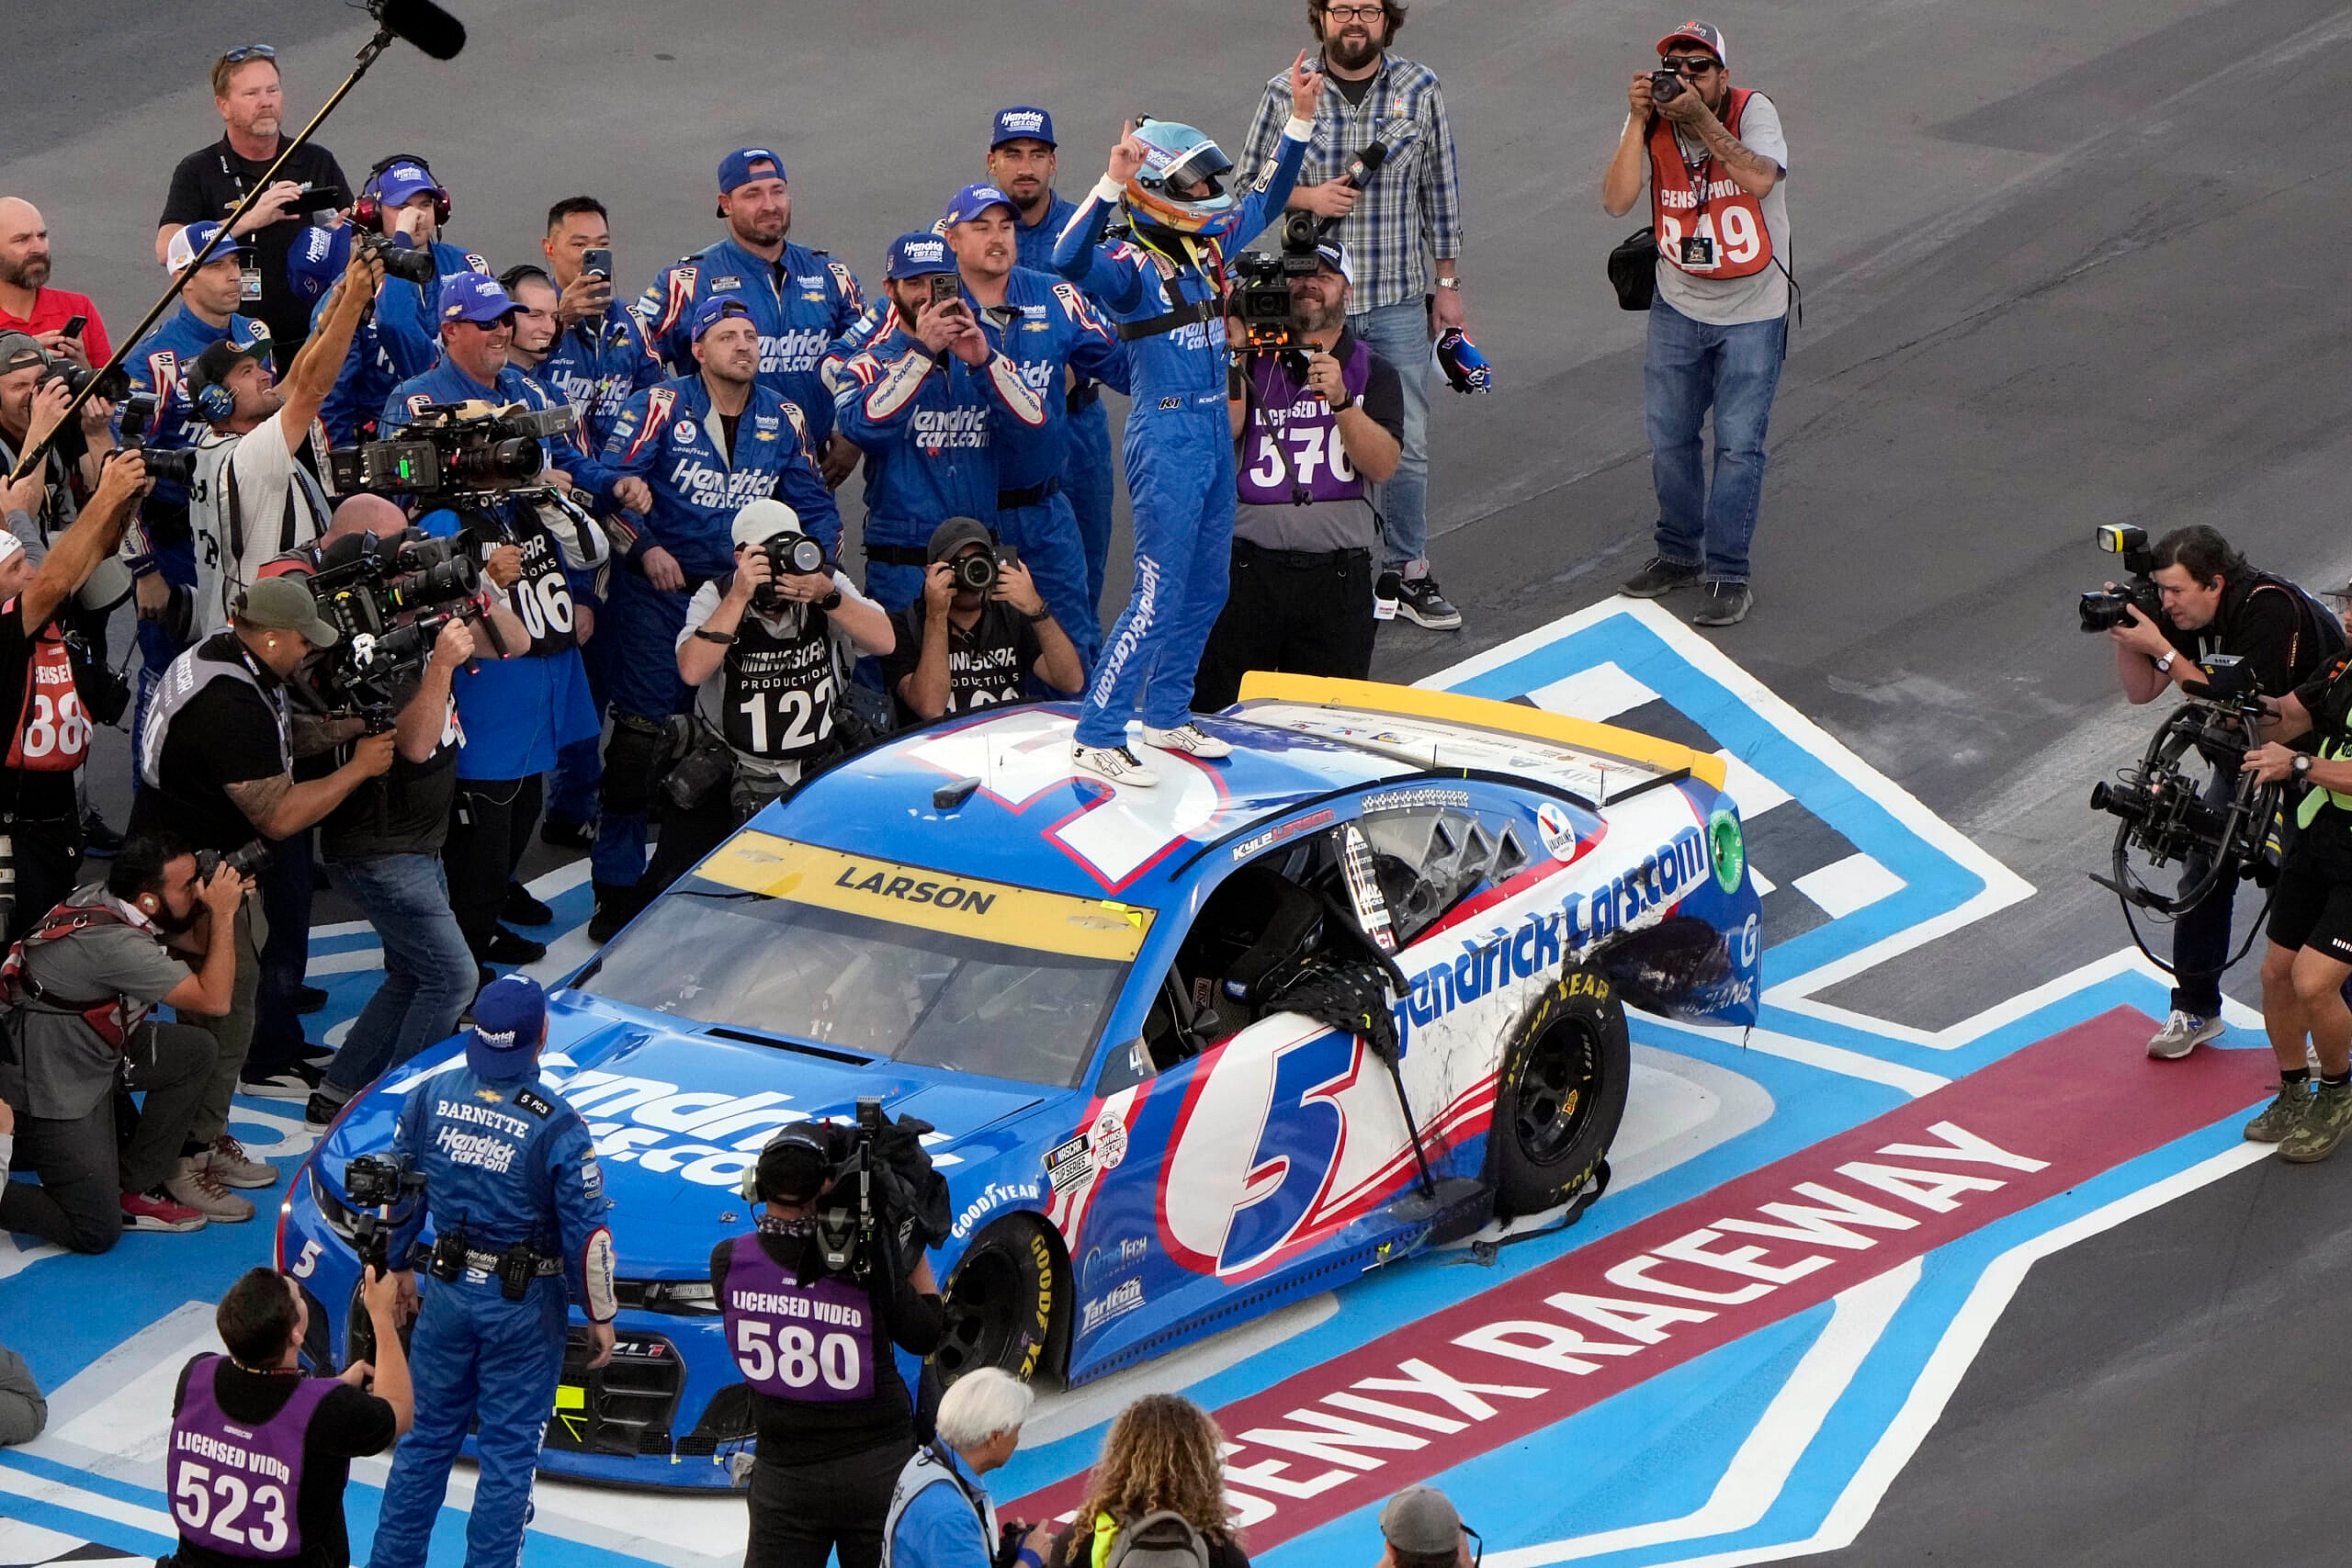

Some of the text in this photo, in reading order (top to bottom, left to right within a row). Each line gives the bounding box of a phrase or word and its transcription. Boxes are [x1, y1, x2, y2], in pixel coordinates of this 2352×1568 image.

[1661, 188, 1698, 209] CENS
[758, 328, 831, 356] ndrick
[670, 458, 781, 497] Hendrick
[691, 490, 770, 510] cars.co
[834, 866, 997, 916] LARSON
[436, 1100, 530, 1139] BARNETTE
[436, 1125, 516, 1163] Hendrick
[450, 1149, 510, 1174] cars.om
[1057, 1138, 1083, 1163] NASCAR
[1055, 1156, 1086, 1183] CUP SERIES
[951, 1181, 1039, 1239] GOODYEAR
[291, 1239, 323, 1280] 5
[1451, 1119, 2052, 1376] RACEWAY
[732, 1290, 862, 1328] LICENSED VIDEO
[1017, 1234, 1052, 1383] GOODYE
[737, 1318, 861, 1391] 580
[176, 1430, 290, 1485] LICENSED VIDEO
[175, 1460, 288, 1552] 523
